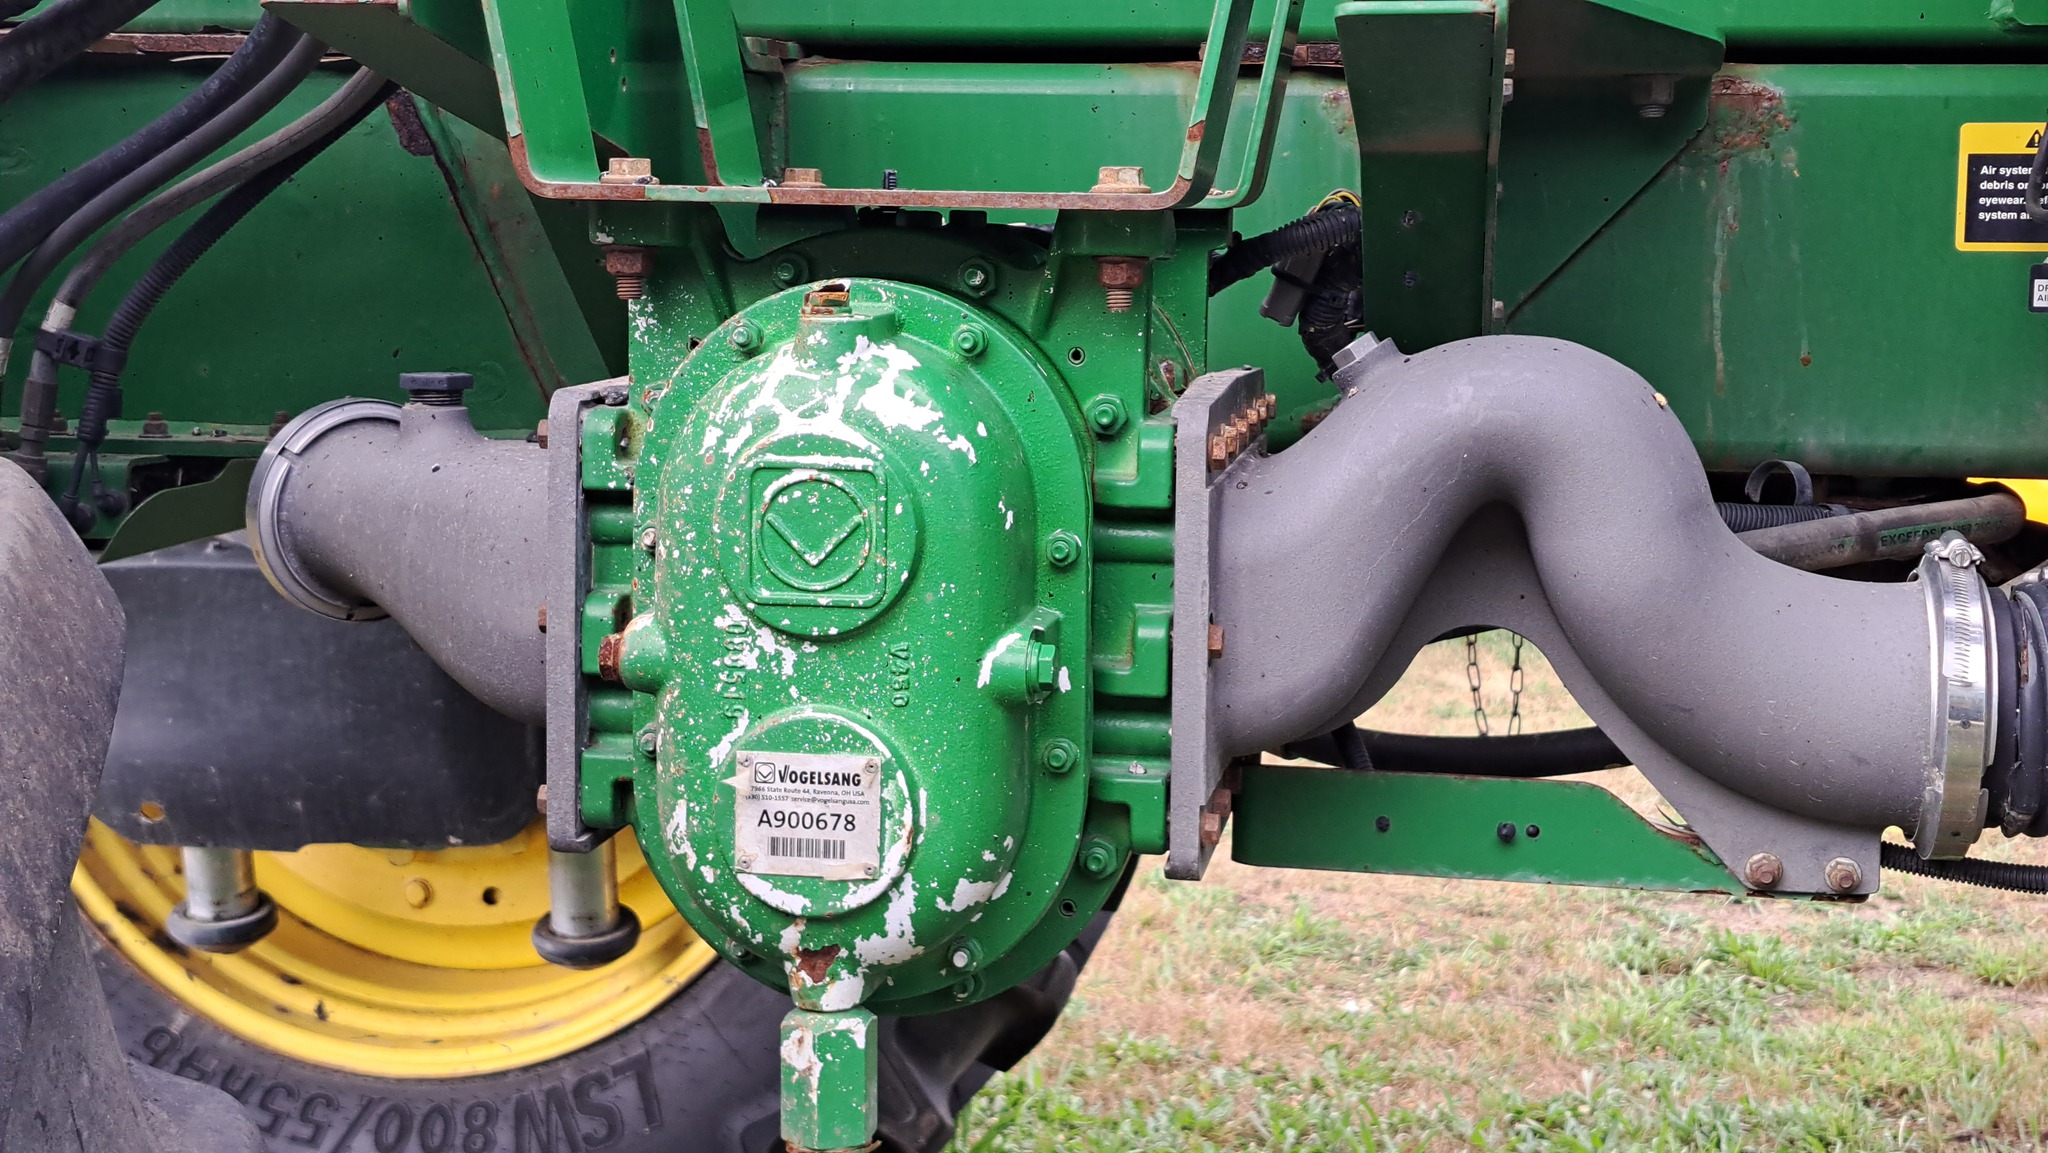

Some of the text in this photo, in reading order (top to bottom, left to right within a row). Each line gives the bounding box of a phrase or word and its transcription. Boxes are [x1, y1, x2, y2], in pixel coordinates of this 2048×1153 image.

[1980, 165, 1997, 174] Air
[1979, 180, 2015, 190] debris
[1979, 196, 2027, 207] eyewear.
[1978, 210, 2018, 222] system
[2037, 294, 2048, 302] AI
[1880, 528, 1937, 547] EXCEEDS
[778, 765, 862, 787] VOGELSANG
[757, 809, 857, 832] A900678
[511, 1048, 665, 1153] LSW
